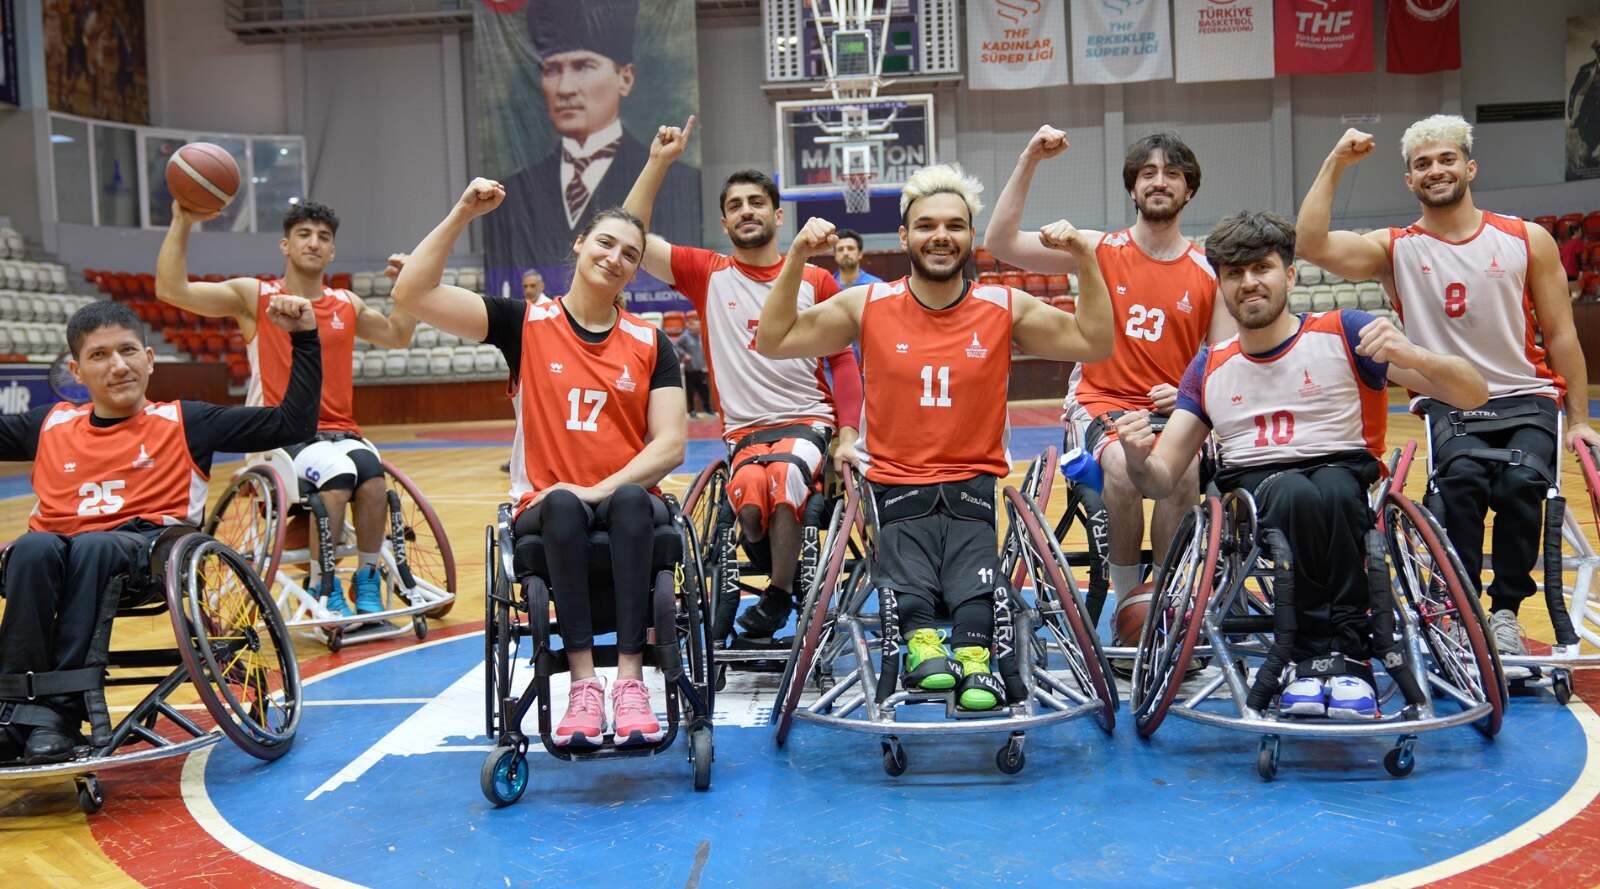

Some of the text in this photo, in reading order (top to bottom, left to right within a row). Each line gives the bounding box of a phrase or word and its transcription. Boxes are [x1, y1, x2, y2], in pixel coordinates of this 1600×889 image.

[1198, 5, 1253, 19] TÜRKİYE
[1198, 18, 1253, 27] BASKETBOL
[1295, 10, 1354, 34] THF
[1004, 28, 1031, 38] THF
[1109, 21, 1134, 31] THF
[982, 39, 1051, 51] KADINLAR
[1087, 32, 1156, 45] ERKEKLER
[981, 52, 1025, 63] SÜPER
[1445, 282, 1466, 319] 8
[1125, 303, 1166, 342] 23
[920, 366, 952, 407] 11
[566, 388, 608, 432] 17
[1254, 410, 1295, 448] 10
[305, 467, 320, 482] 6
[77, 479, 126, 517] 25
[395, 511, 406, 565] EXTRA
[977, 567, 993, 585] 11
[994, 586, 1014, 658] EXTRA
